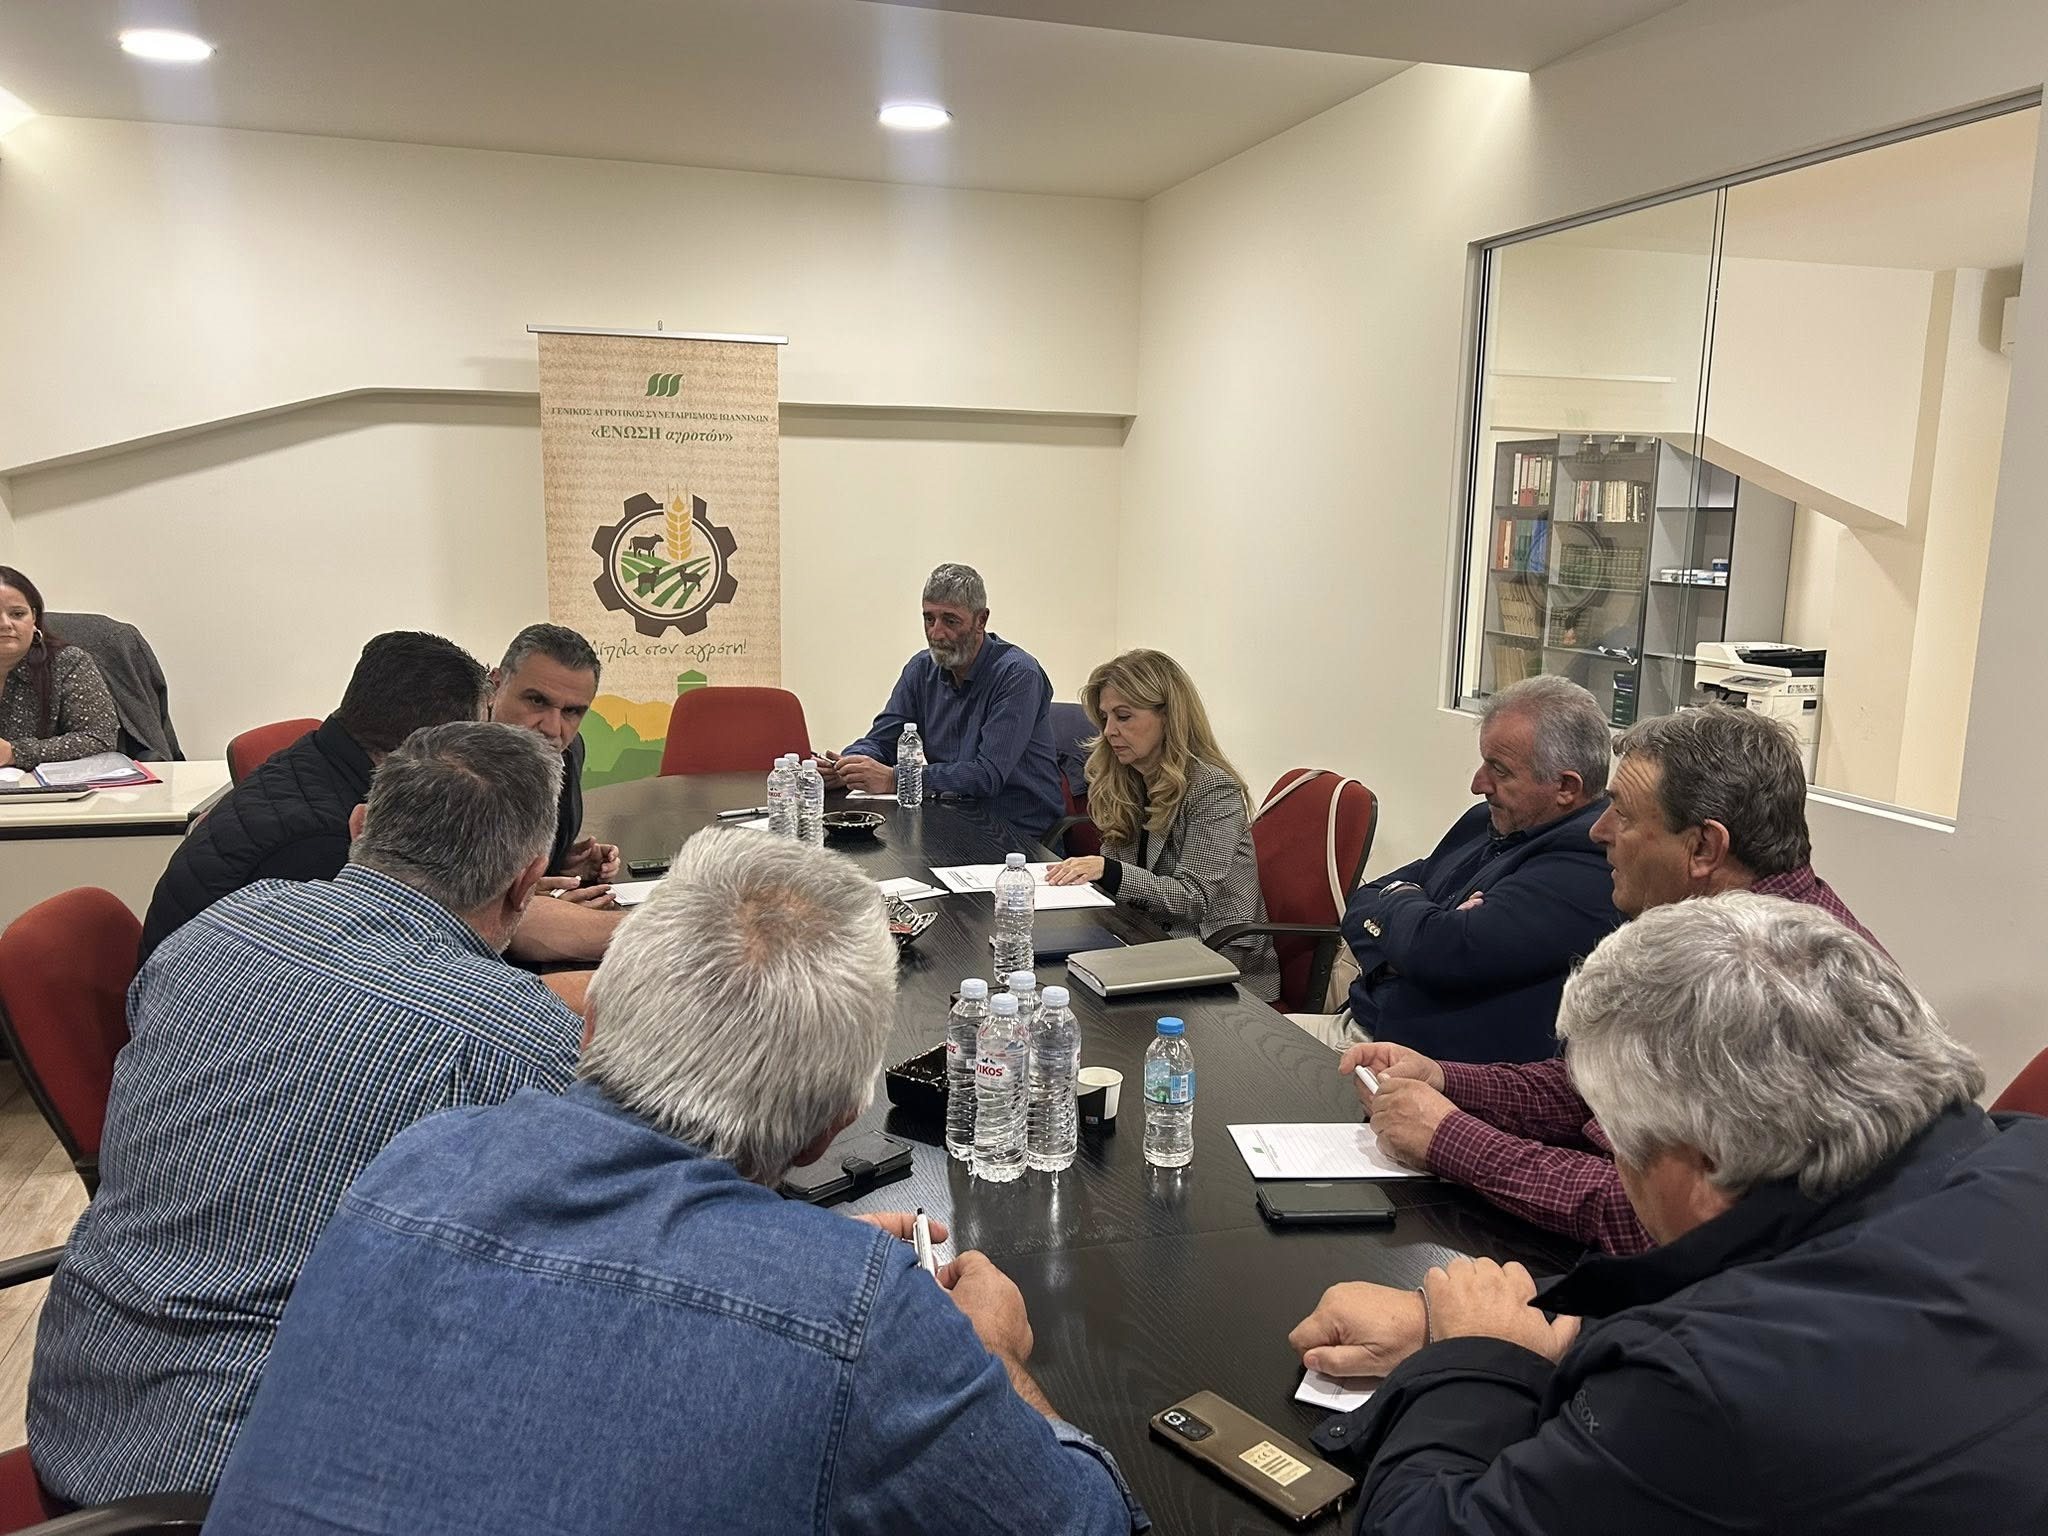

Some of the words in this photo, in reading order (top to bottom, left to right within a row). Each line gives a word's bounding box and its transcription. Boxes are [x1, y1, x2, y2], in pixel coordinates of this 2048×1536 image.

[552, 407, 592, 416] ΓΕΝΙΚΟΣ
[594, 408, 644, 417] ΑΓΡΟΤΙΚΟΣ
[646, 410, 718, 420] ΣΥΝΕΤΑΙΡΙΣΜΟΣ
[719, 413, 769, 422] ΙΩΑΝΝΙΝΩΝ
[591, 425, 661, 440] «ΕΝΩΣΗ
[665, 429, 733, 444] αγροτών»
[645, 643, 679, 655] στον
[685, 639, 747, 663] αγρότη!
